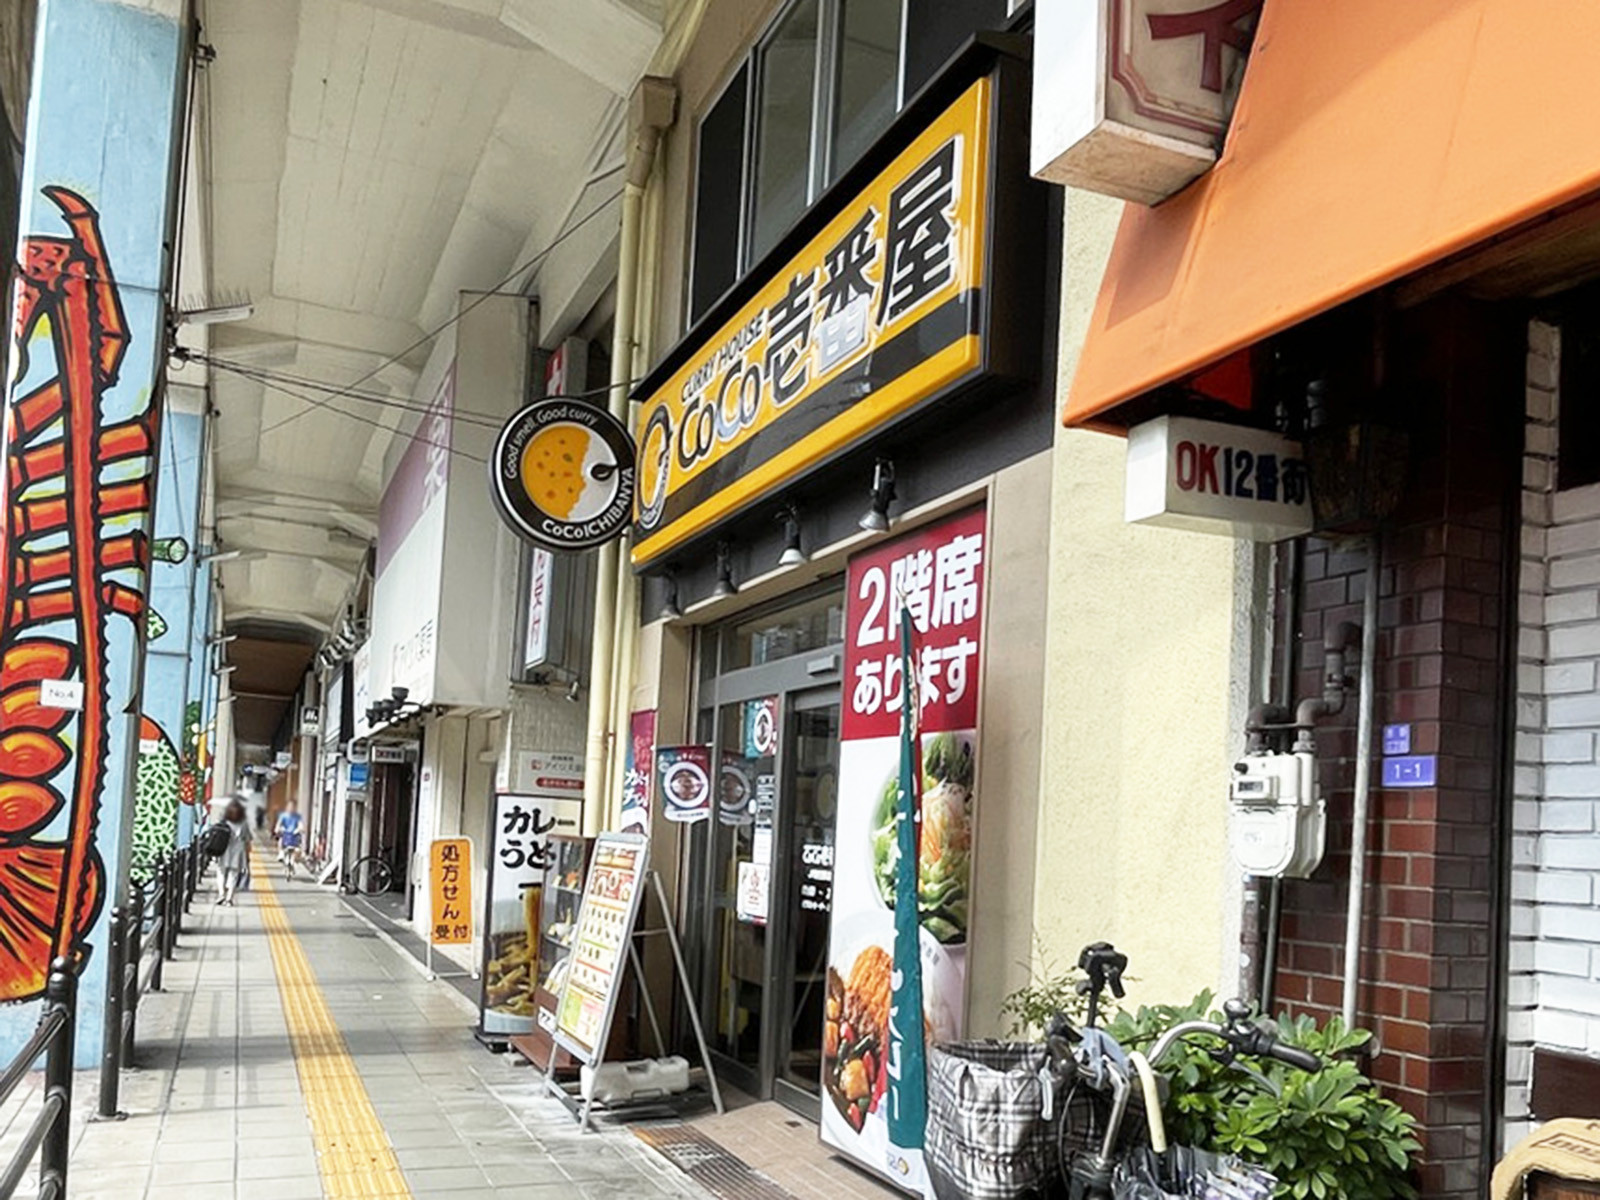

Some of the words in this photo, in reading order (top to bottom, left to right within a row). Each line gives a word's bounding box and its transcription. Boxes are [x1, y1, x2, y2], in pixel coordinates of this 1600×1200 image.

[683, 351, 720, 402] CURRY
[719, 308, 768, 365] HOUSE
[505, 444, 517, 479] Good
[536, 406, 568, 424] Good
[568, 409, 599, 426] curry
[856, 533, 982, 647] 2階席
[1394, 763, 1421, 779] 1-1
[503, 805, 576, 836] カレー
[441, 844, 460, 920] 処方せん
[435, 925, 468, 940] 受付
